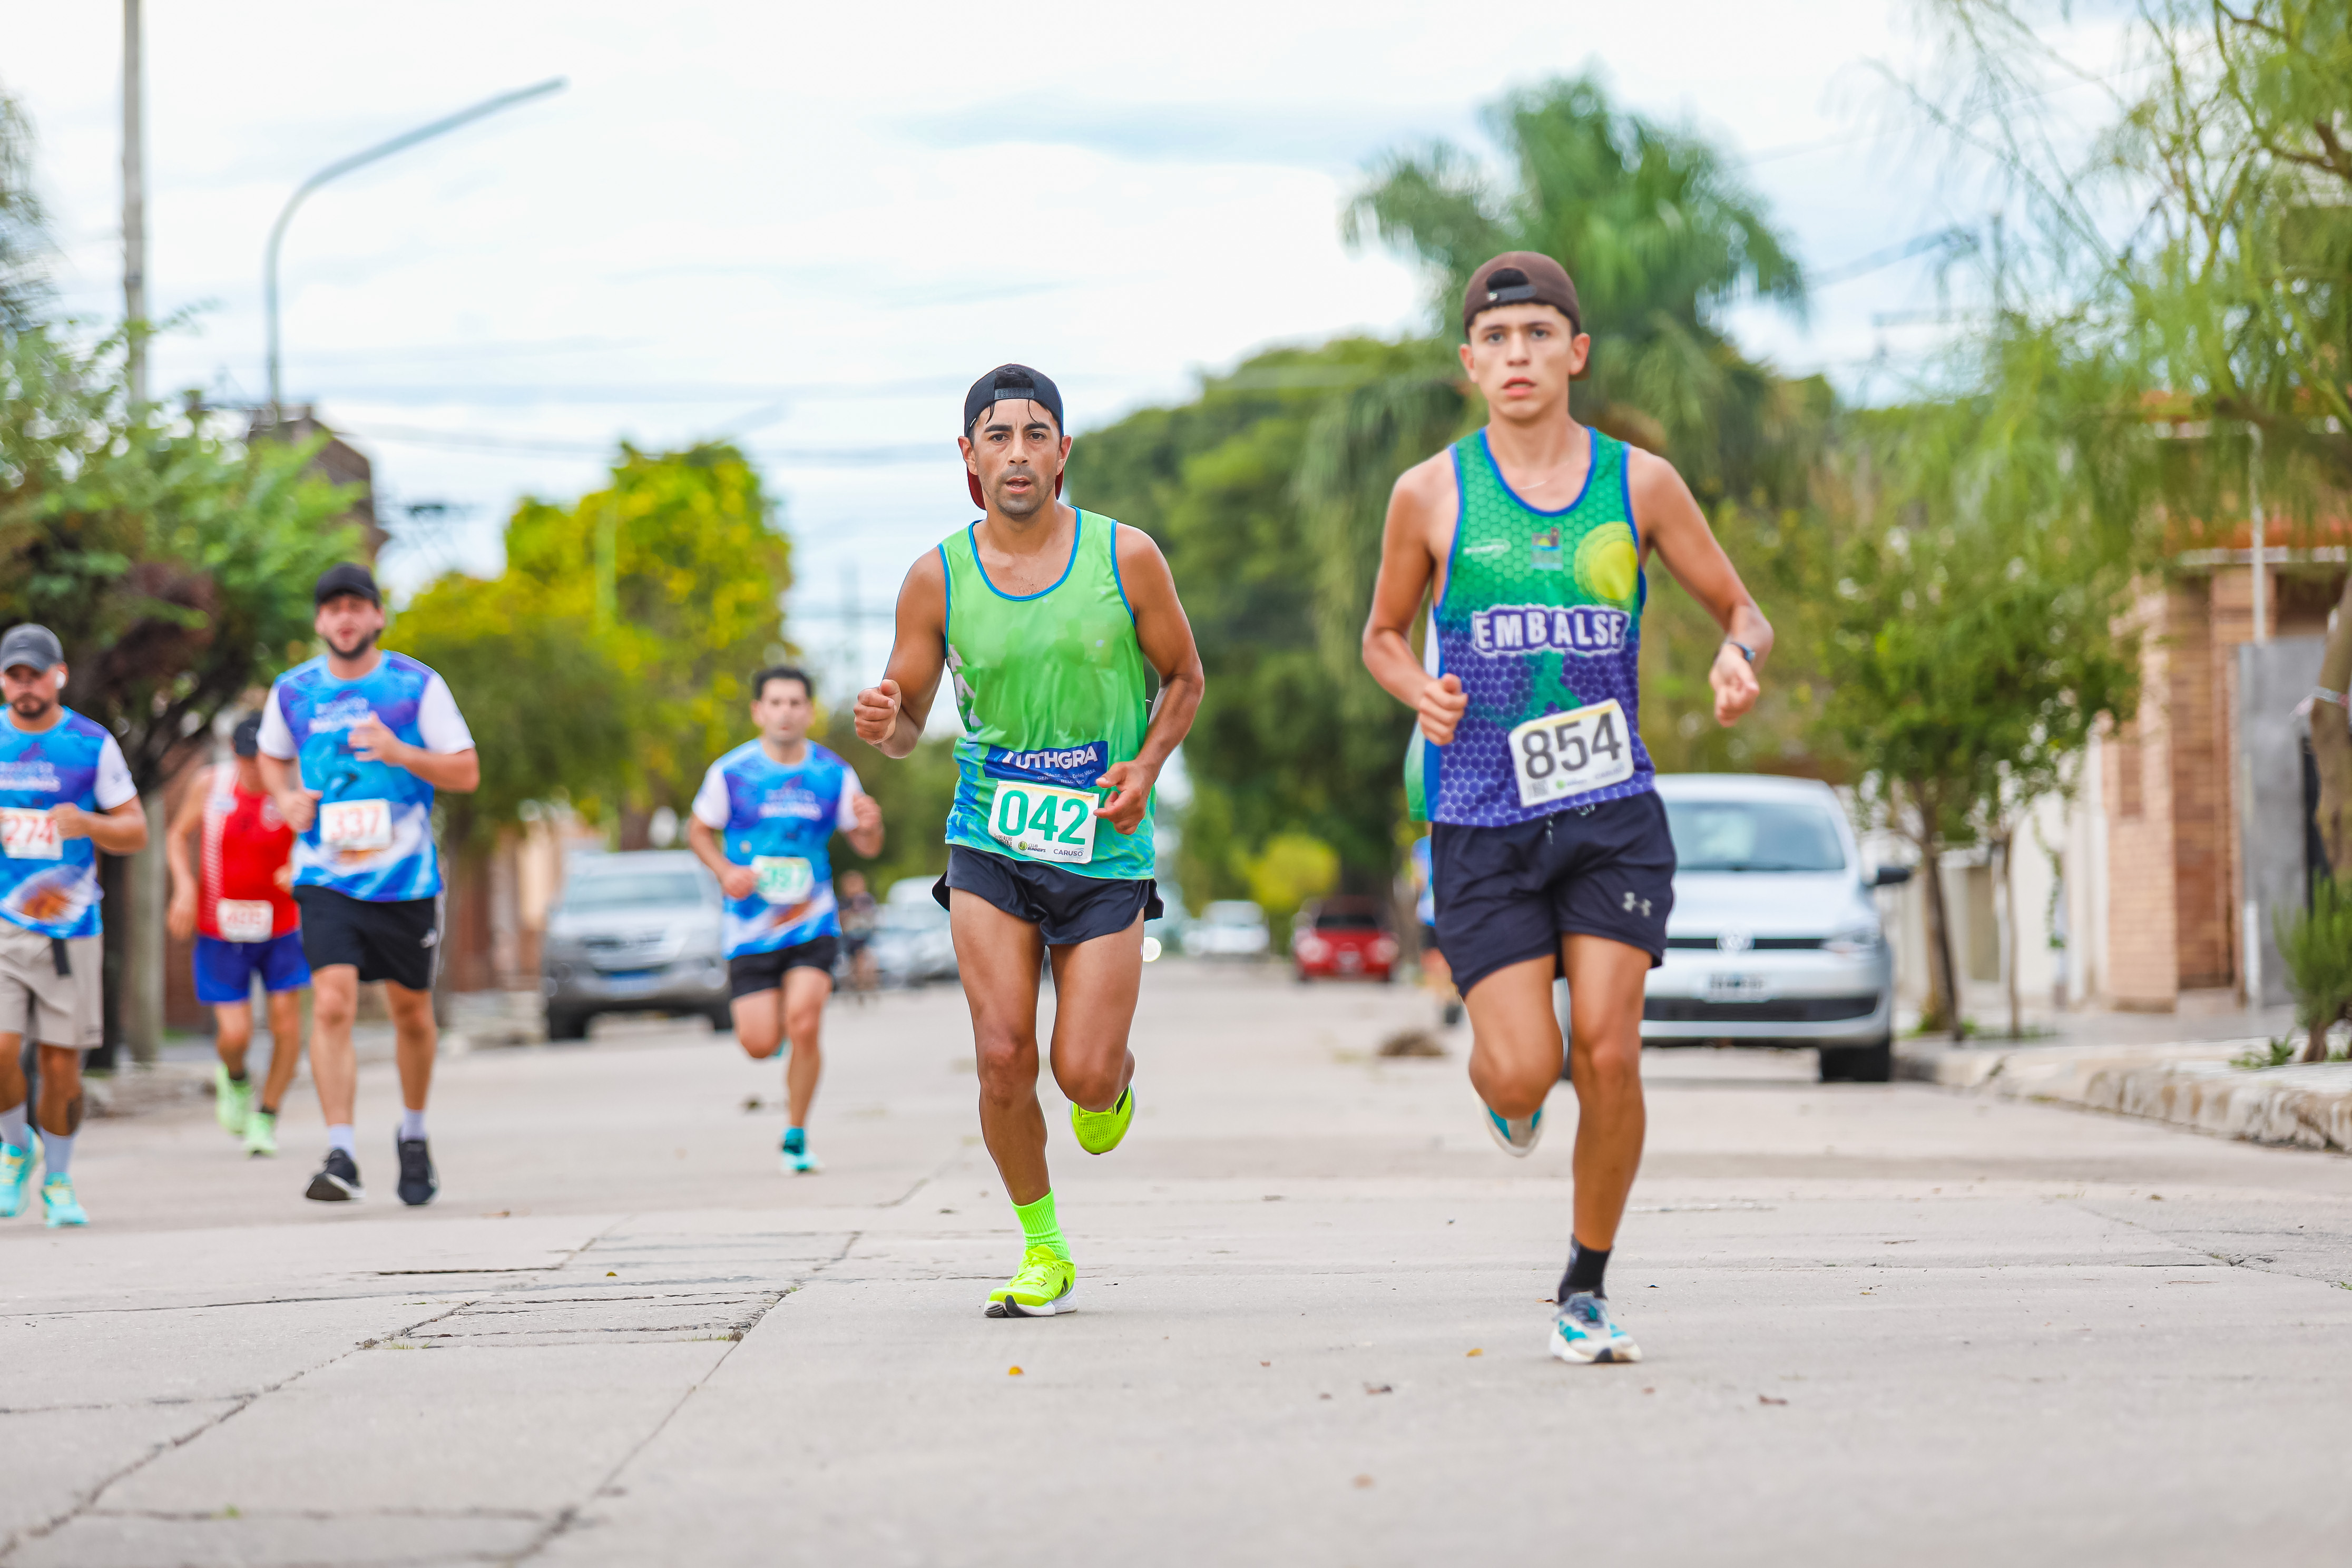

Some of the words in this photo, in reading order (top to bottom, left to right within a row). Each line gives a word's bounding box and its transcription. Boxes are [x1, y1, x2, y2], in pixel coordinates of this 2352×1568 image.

[1476, 611, 1623, 649] EMBALSE
[1522, 712, 1622, 779] 854
[329, 806, 381, 841] 337
[998, 790, 1089, 845] 042
